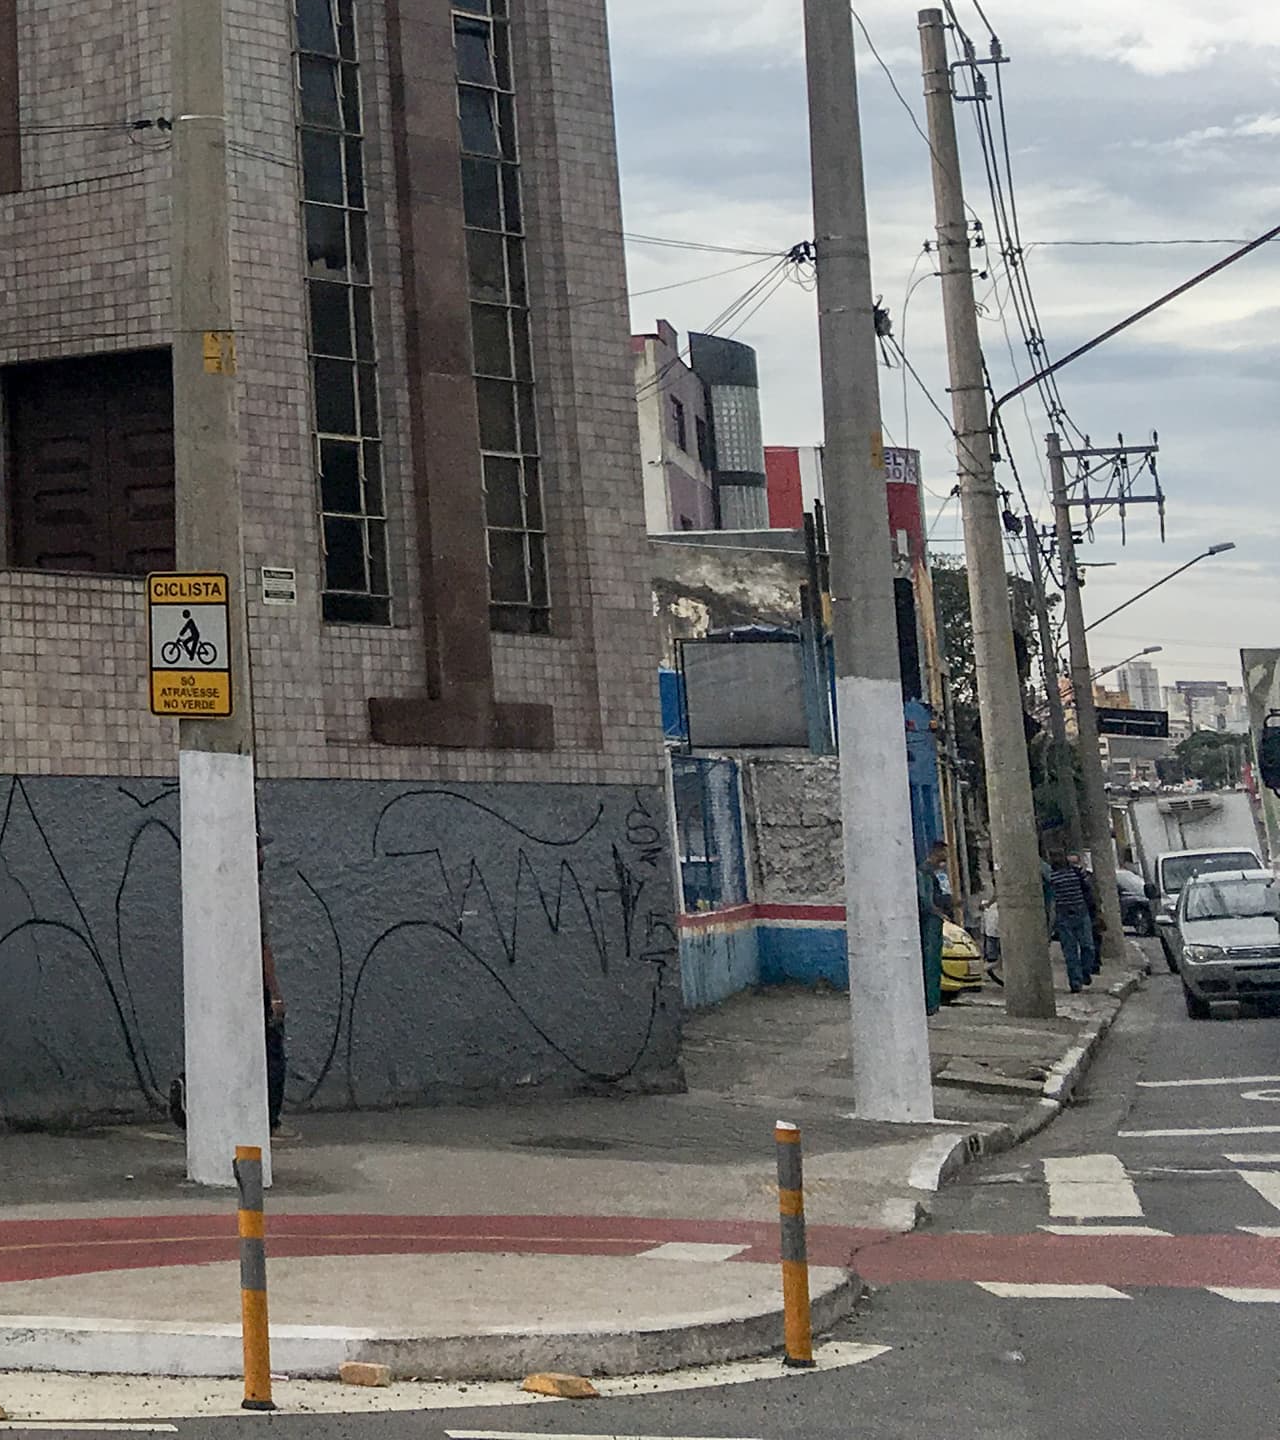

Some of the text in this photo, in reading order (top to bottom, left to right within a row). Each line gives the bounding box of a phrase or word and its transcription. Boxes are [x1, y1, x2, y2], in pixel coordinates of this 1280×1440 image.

[154, 582, 222, 597] CICLISTA
[160, 688, 220, 698] ATRAVESSE
[163, 699, 216, 710] NO VERDE
